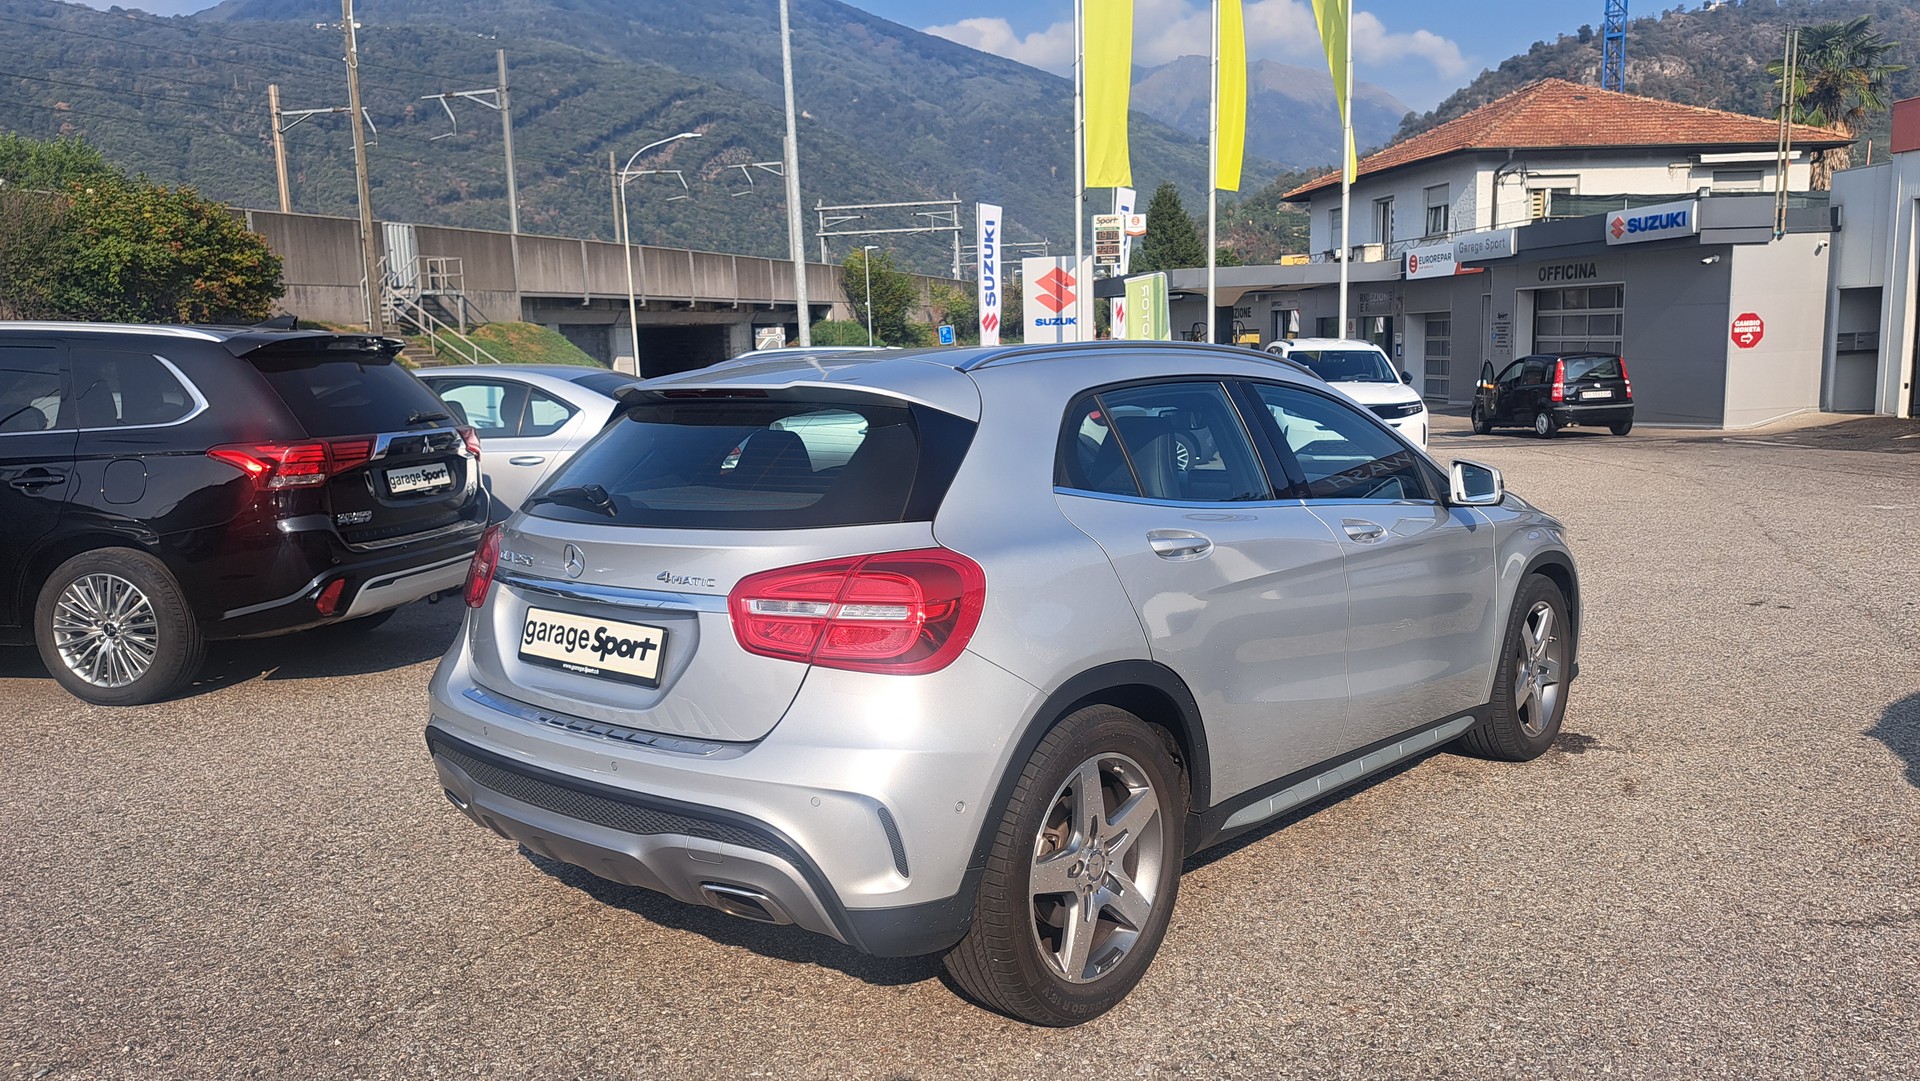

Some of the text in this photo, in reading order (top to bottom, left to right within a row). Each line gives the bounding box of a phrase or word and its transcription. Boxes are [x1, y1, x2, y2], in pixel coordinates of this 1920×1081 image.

[1096, 216, 1119, 227] Sport
[1627, 211, 1687, 234] SUZUKI
[1459, 238, 1506, 255] Garage Sport
[985, 220, 996, 307] SUZUKI
[1419, 252, 1452, 265] EUROREPAR
[1538, 262, 1597, 281] OFFICINA
[1035, 317, 1077, 326] SUZUK
[1233, 307, 1251, 319] ZIONE
[390, 468, 446, 489] garage Sport
[657, 570, 716, 587] 4MATIC
[524, 620, 657, 661] garage Sport
